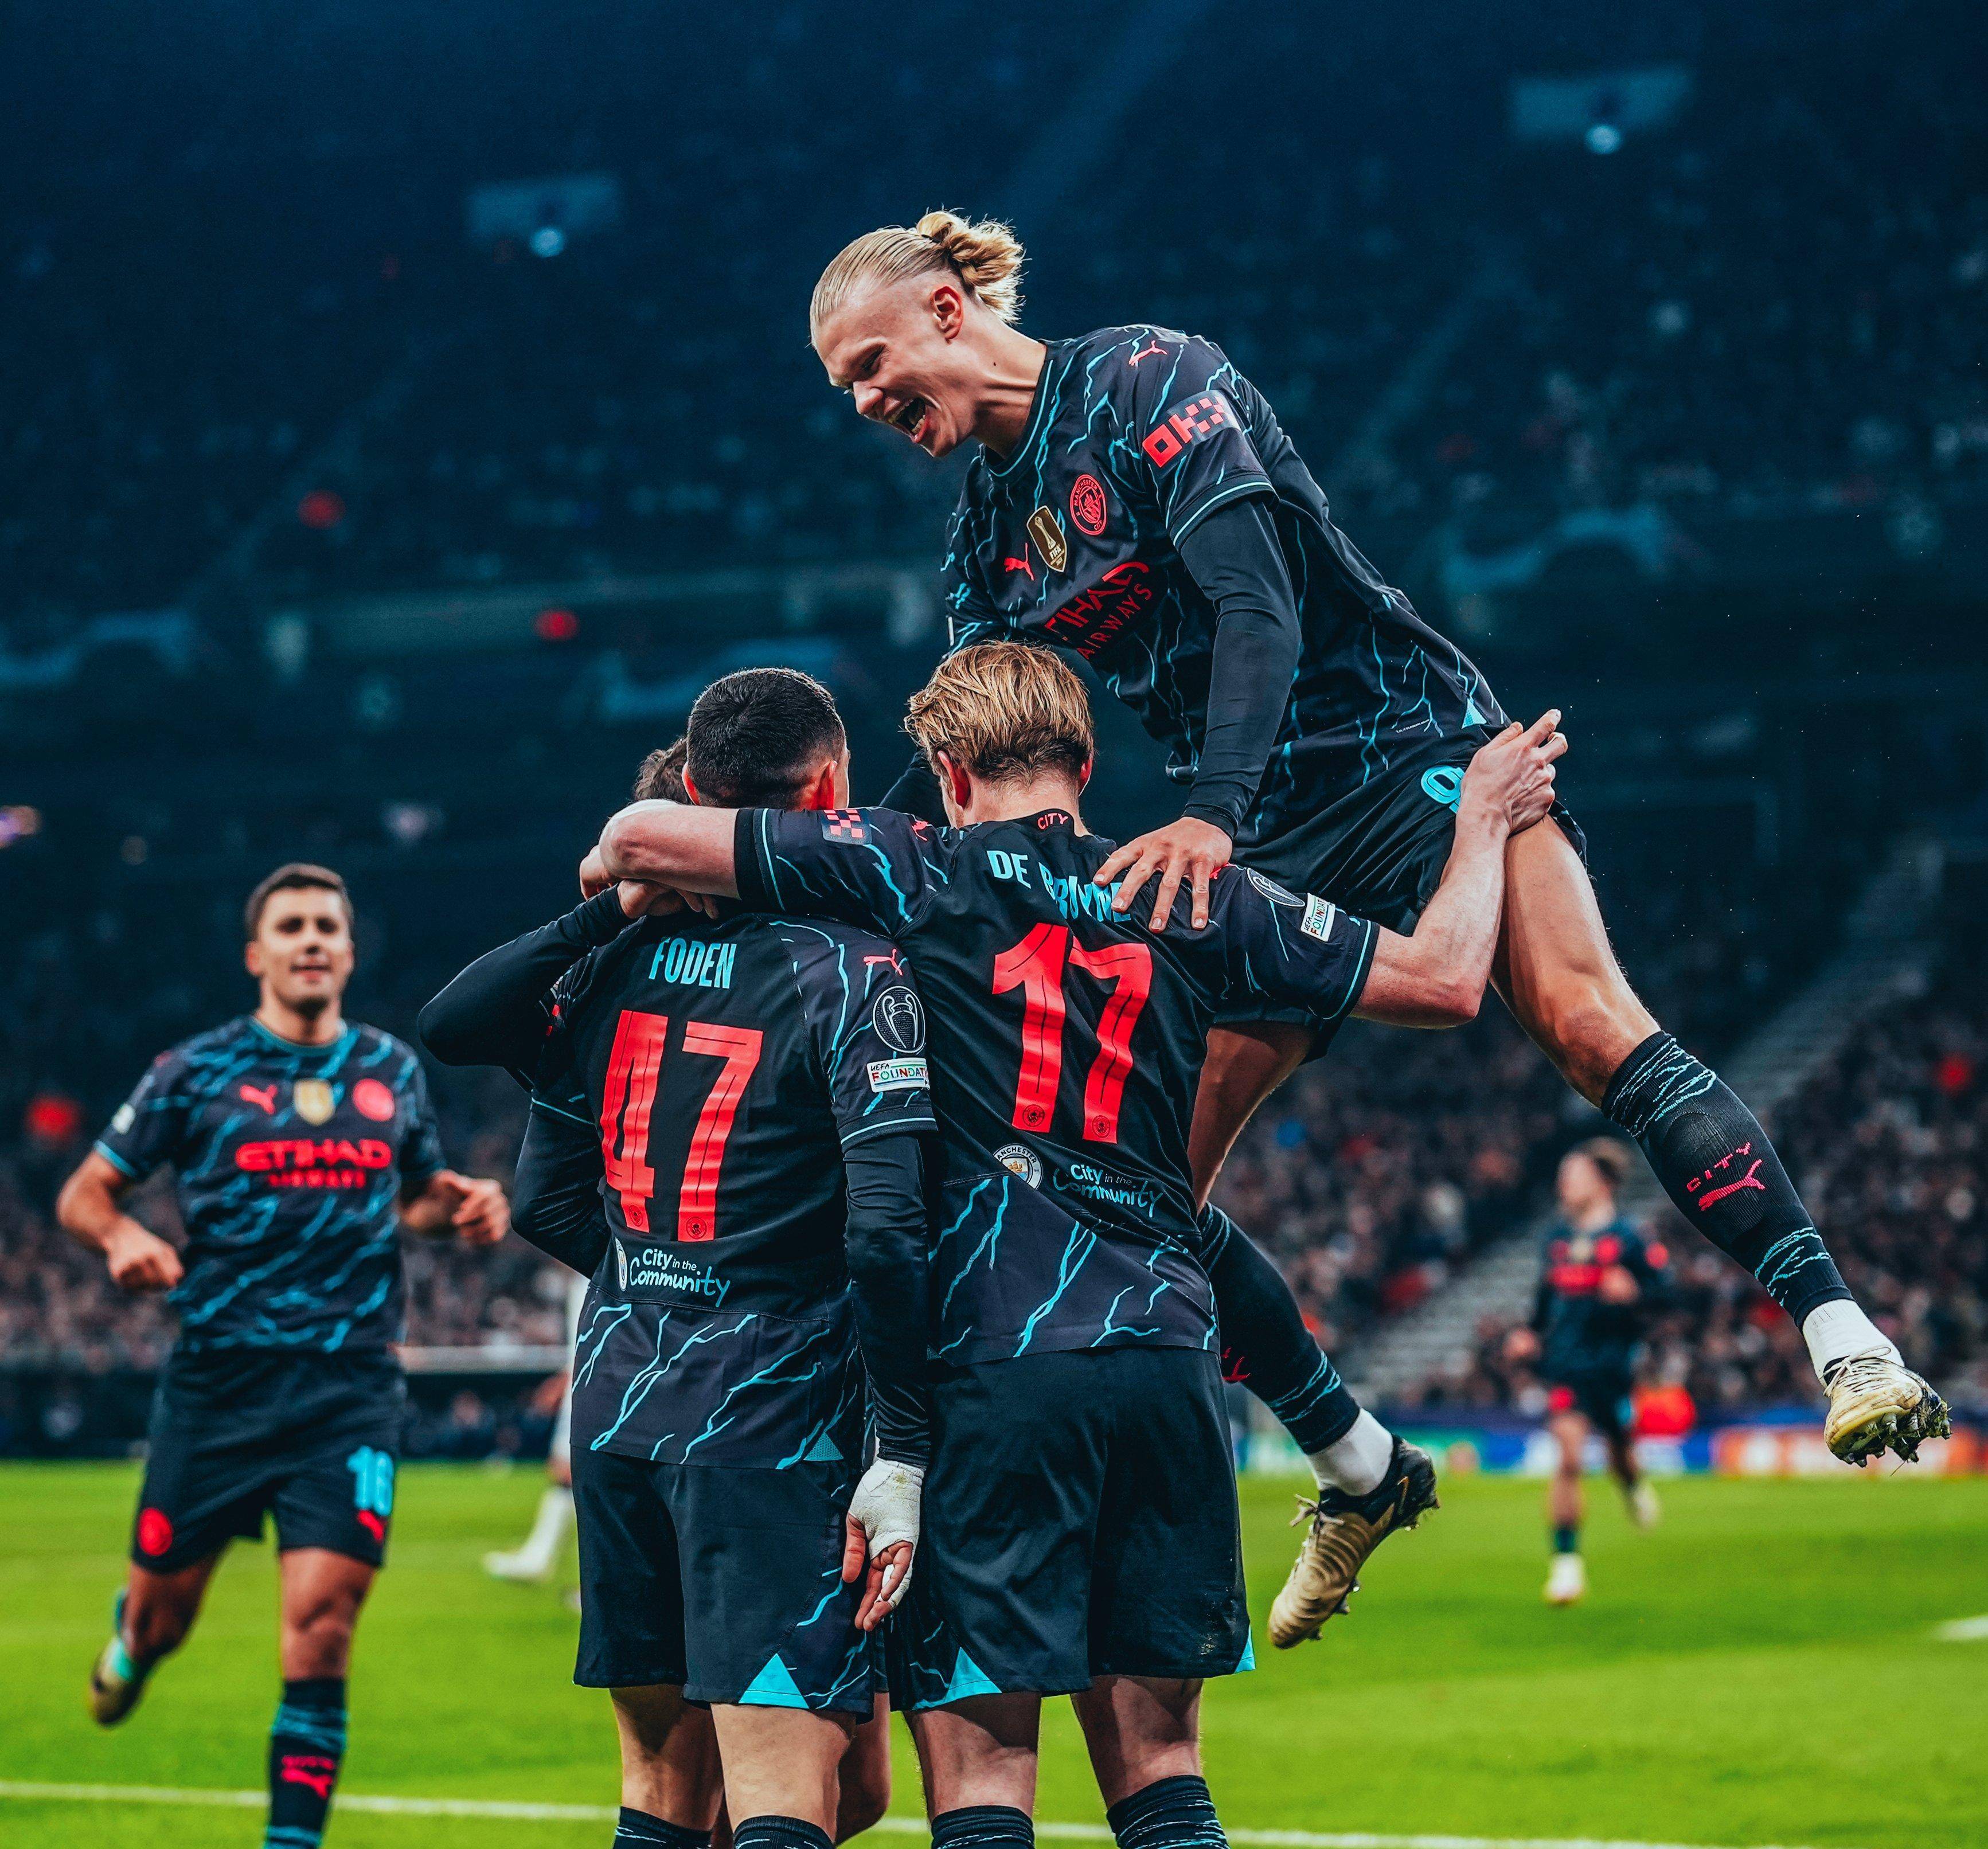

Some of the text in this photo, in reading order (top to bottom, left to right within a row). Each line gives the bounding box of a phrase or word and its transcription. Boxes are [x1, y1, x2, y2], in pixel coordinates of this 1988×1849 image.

[1074, 479, 1097, 506] MANCHESTER
[1049, 545, 1062, 560] FIFA
[1076, 583, 1153, 660] AIRWAYS
[1421, 765, 1464, 814] 9
[1037, 812, 1069, 830] CITY
[987, 850, 1031, 889] DE
[1304, 917, 1312, 931] UEFA
[1310, 899, 1326, 936] FOUNDAT
[648, 937, 737, 989] FODEN
[992, 922, 1153, 1144] 17
[871, 1063, 889, 1071] UEFA
[600, 1010, 763, 1242] 47
[236, 1137, 392, 1171] ETIHAD
[998, 1147, 1037, 1163] ANCHESTER
[1686, 1142, 1751, 1192] CITY
[1053, 1168, 1163, 1218] Community
[1071, 1164, 1132, 1185] City in the
[643, 1248, 697, 1271] City in the
[630, 1257, 731, 1308] Community
